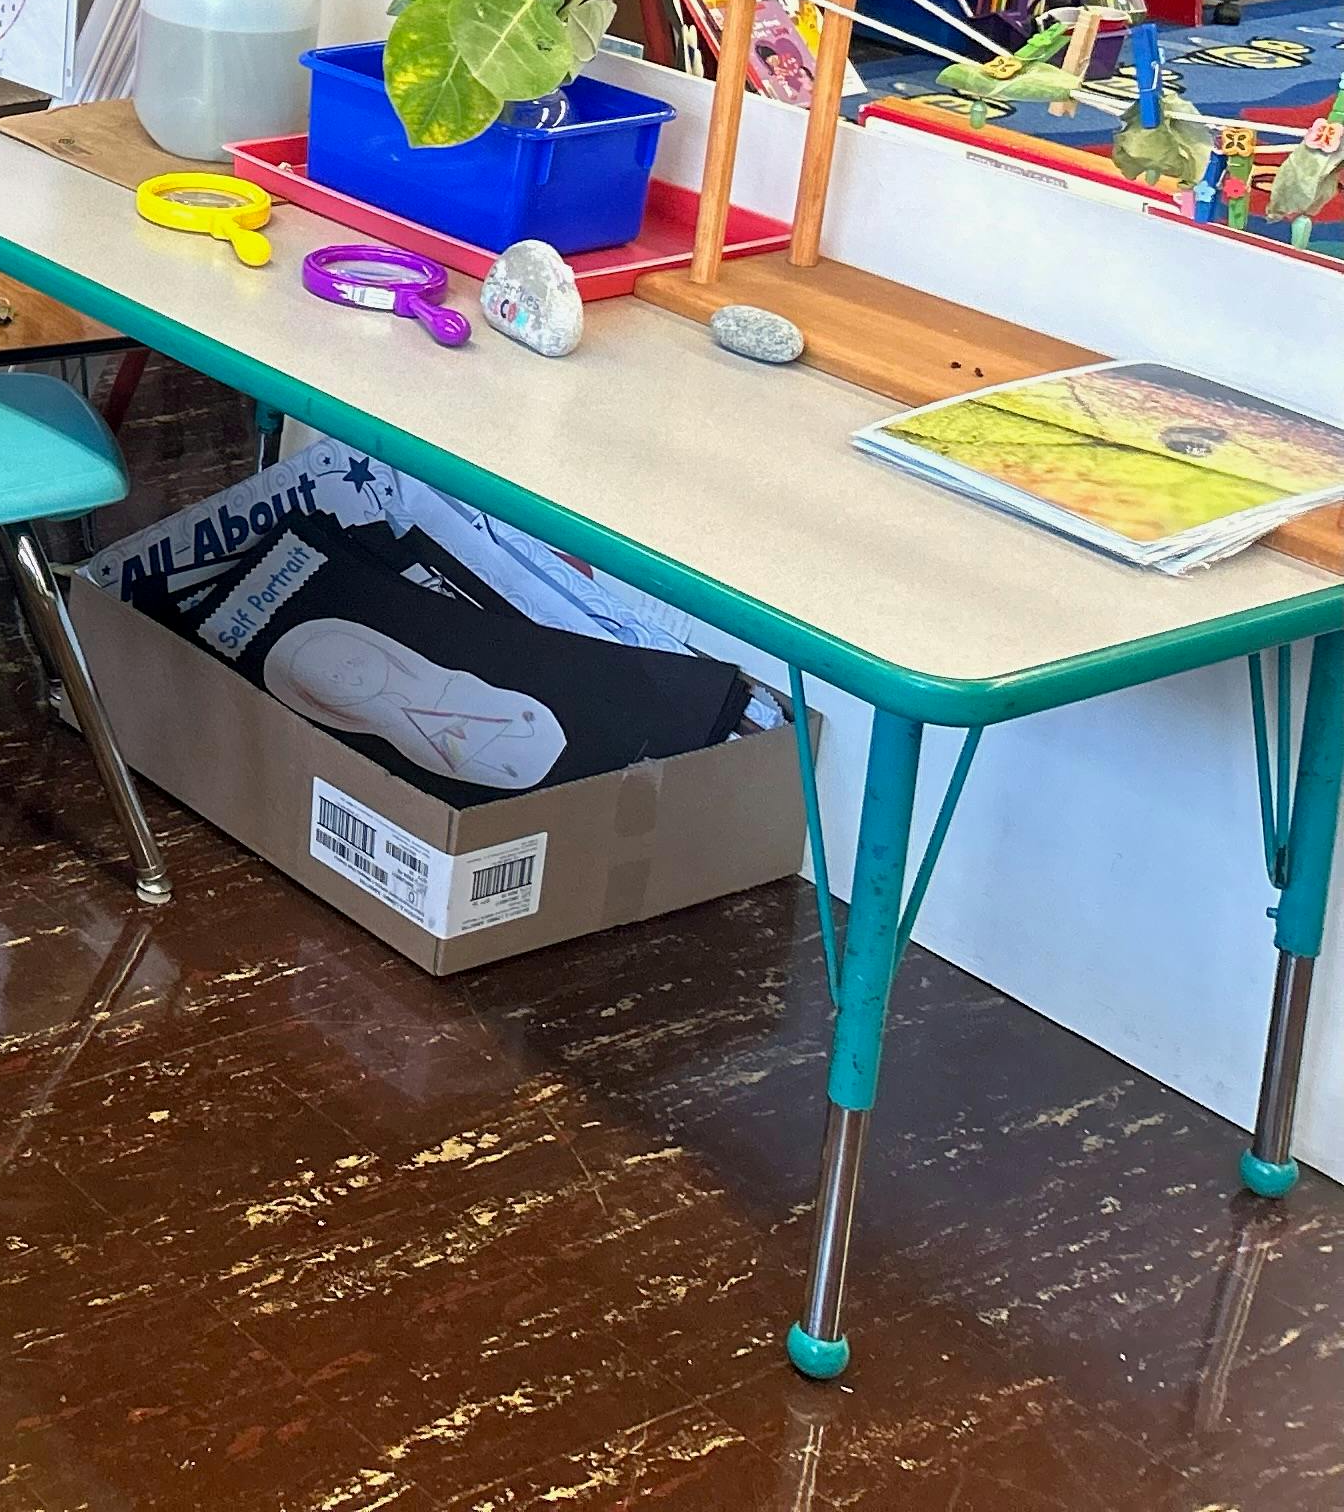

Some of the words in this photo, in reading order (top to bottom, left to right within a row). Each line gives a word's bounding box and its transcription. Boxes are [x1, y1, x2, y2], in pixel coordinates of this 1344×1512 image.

[120, 534, 175, 604] All
[194, 472, 317, 568] About
[217, 608, 258, 649] Self
[247, 546, 311, 613] Portrait
